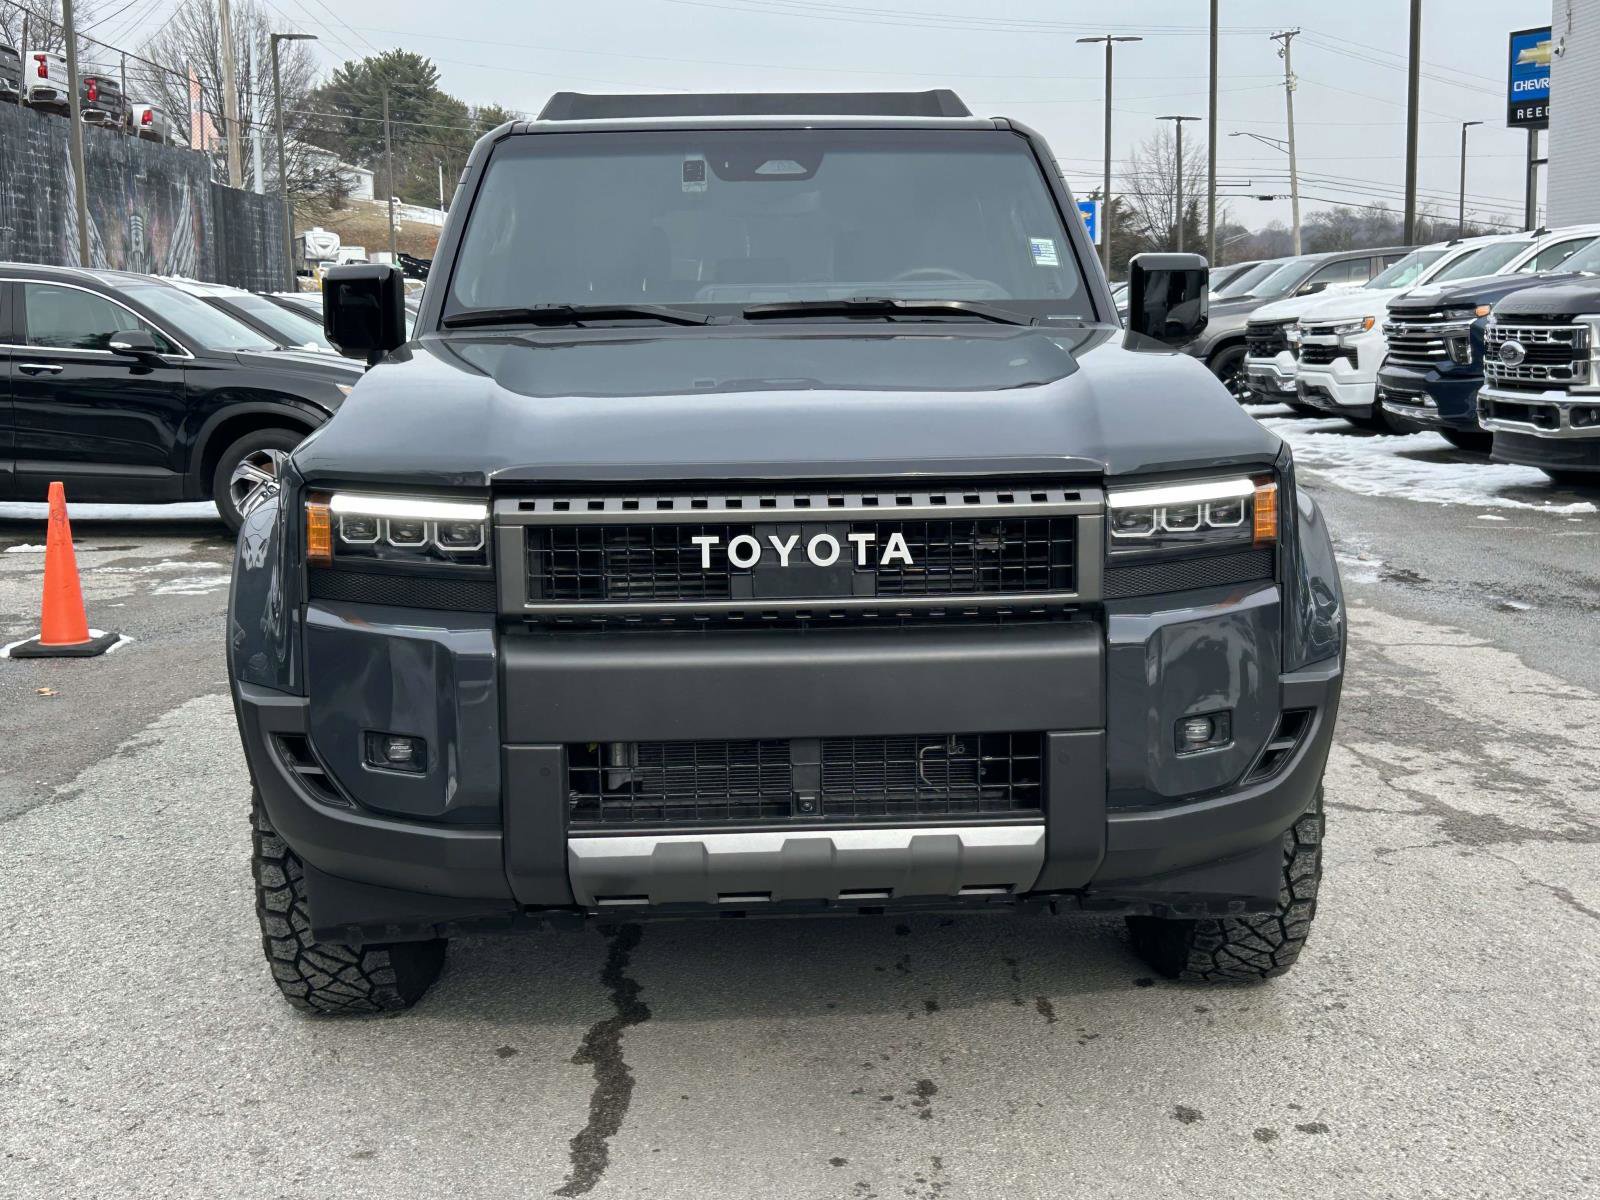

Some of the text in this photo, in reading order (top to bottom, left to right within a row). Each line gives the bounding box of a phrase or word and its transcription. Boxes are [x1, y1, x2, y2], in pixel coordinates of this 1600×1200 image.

[1513, 77, 1550, 92] CHEVR
[1517, 106, 1550, 119] REED
[691, 532, 914, 569] TOYOTA
